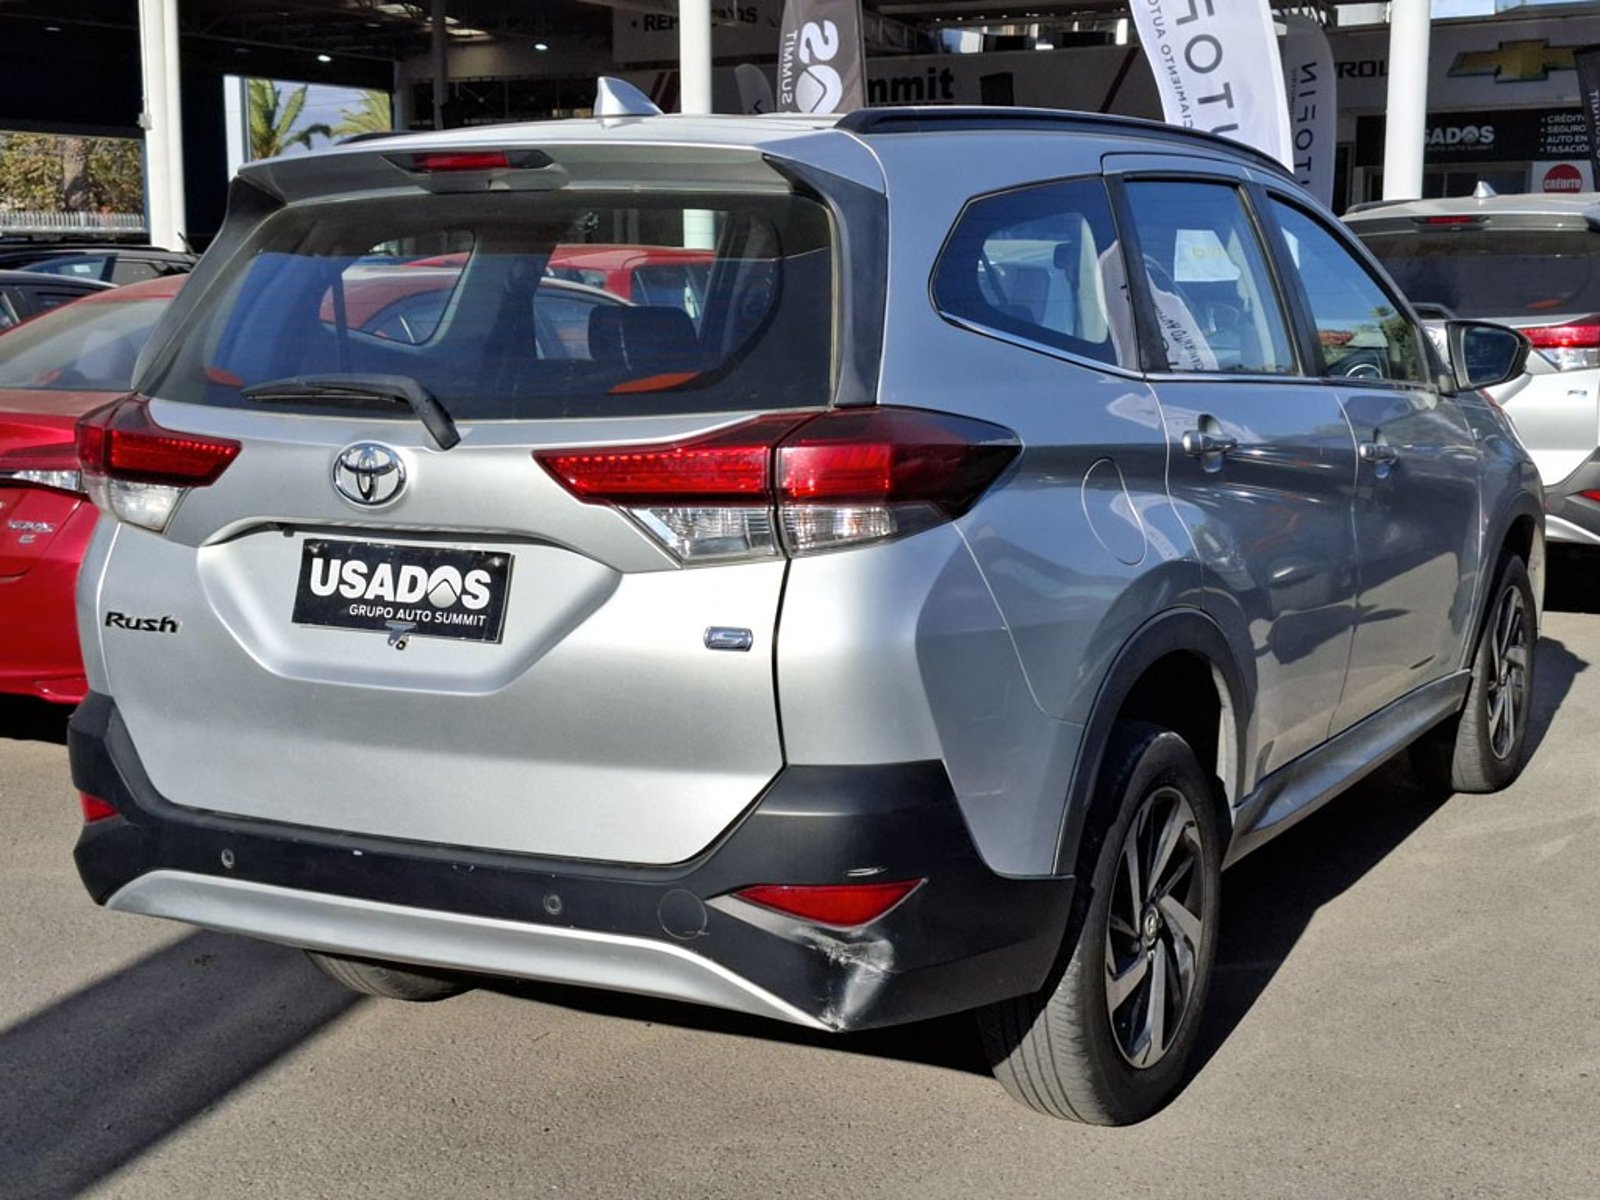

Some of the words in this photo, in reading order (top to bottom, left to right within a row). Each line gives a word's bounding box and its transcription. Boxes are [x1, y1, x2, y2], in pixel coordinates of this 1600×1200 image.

[1546, 113, 1585, 124] CRÉDIT
[309, 557, 492, 610] USADOS
[104, 611, 178, 634] Rush
[349, 603, 394, 619] GRUPO
[396, 608, 432, 623] AUTO
[434, 611, 487, 627] SUMMIT
